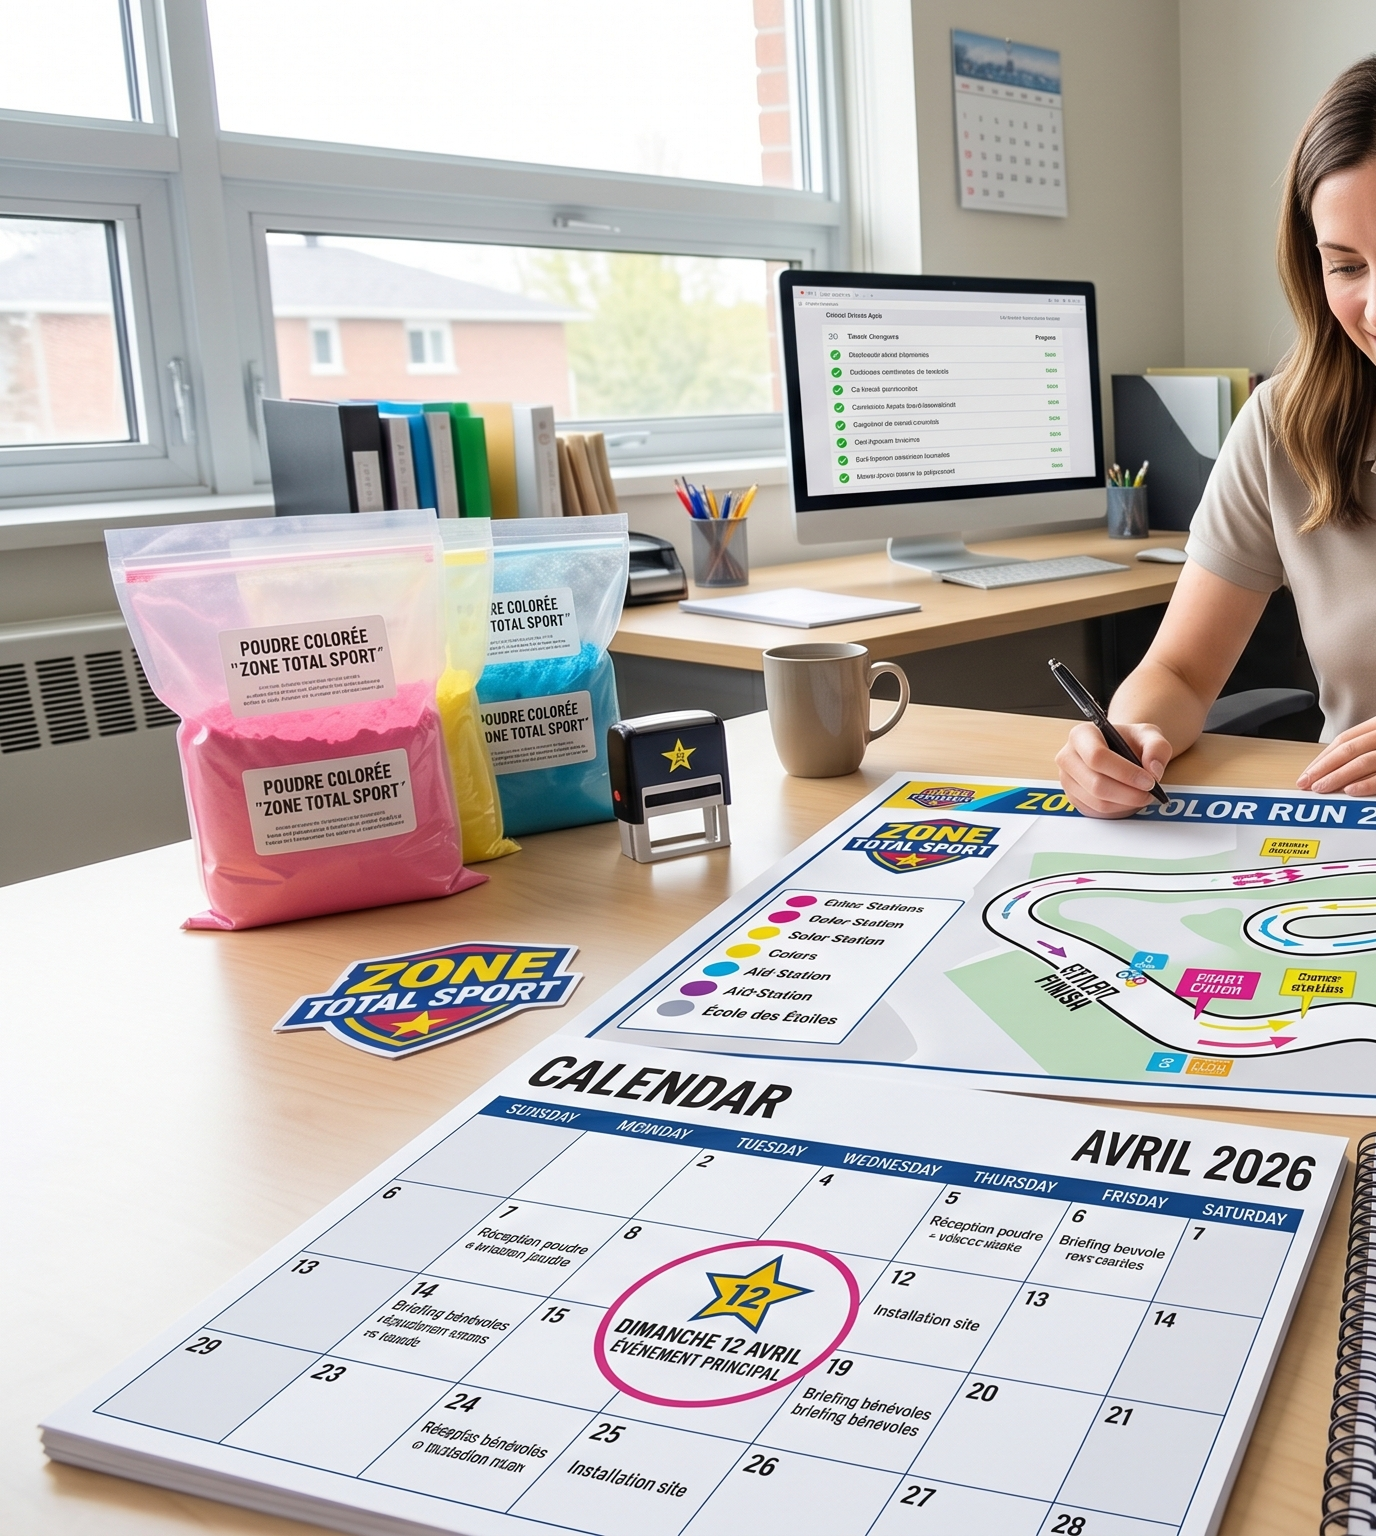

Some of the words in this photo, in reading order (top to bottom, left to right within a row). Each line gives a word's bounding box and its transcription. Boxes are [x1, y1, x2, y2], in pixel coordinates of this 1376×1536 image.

[507, 595, 559, 614] COLORÉE
[490, 617, 525, 632] TOTAL
[240, 635, 301, 657] POUDRE
[303, 626, 369, 650] COLORÉE
[282, 653, 327, 672] TOTAL
[527, 700, 579, 722] COLORÉE
[510, 725, 547, 740] TOTAL
[263, 772, 324, 796] POUDRE
[327, 761, 392, 786] COLORÉE
[305, 791, 350, 811] TOTAL
[1267, 802, 1347, 824] RUN
[876, 823, 994, 845] ZONE
[852, 837, 914, 852] TOTAL
[918, 841, 998, 856] SPORT
[345, 950, 557, 995] ZONE
[304, 991, 419, 1020] TOTAL
[427, 980, 562, 1007] SPORT
[702, 1004, 748, 1018] École
[750, 1009, 780, 1021] des
[528, 1055, 792, 1119] CALENDAR
[695, 1154, 715, 1169] 2
[1071, 1129, 1193, 1177] AVRIL
[1203, 1145, 1316, 1192] 2026
[737, 1137, 809, 1157] TUESDAY
[843, 1152, 943, 1178] WEDNESDAY
[973, 1170, 1059, 1194] THURSDAY
[1101, 1189, 1169, 1210] FRISDAY
[1202, 1203, 1289, 1227] SATURDAY
[818, 1173, 835, 1187] 4
[381, 1186, 402, 1200] 6
[945, 1191, 961, 1205] 5
[499, 1205, 519, 1219] 7
[1072, 1209, 1087, 1223] 6
[623, 1225, 643, 1241] 8
[996, 1228, 1044, 1242] poudre
[1193, 1226, 1206, 1241] 7
[539, 1241, 589, 1255] poudre
[290, 1259, 320, 1275] 13
[890, 1270, 917, 1287] 12
[410, 1281, 440, 1298] 14
[730, 1284, 772, 1310] 12
[1024, 1291, 1050, 1308] 13
[540, 1306, 570, 1324] 15
[873, 1304, 950, 1330] Installation
[953, 1317, 981, 1332] site
[1153, 1311, 1177, 1328] 14
[185, 1336, 223, 1355] 29
[614, 1317, 720, 1352] DIMANCHE
[719, 1336, 747, 1354] 12
[742, 1340, 803, 1366] AVRIL
[610, 1337, 702, 1369] ÉVÉNEMENT
[699, 1356, 781, 1382] PRINCIPAL
[825, 1357, 854, 1377] 19
[310, 1364, 347, 1382] 23
[444, 1392, 482, 1412] 24
[965, 1382, 1000, 1403] 20
[1104, 1405, 1134, 1427] 21
[588, 1422, 626, 1444] 25
[742, 1454, 779, 1477] 26
[655, 1475, 688, 1498] site
[900, 1485, 936, 1508] 27
[1051, 1513, 1086, 1536] 28
